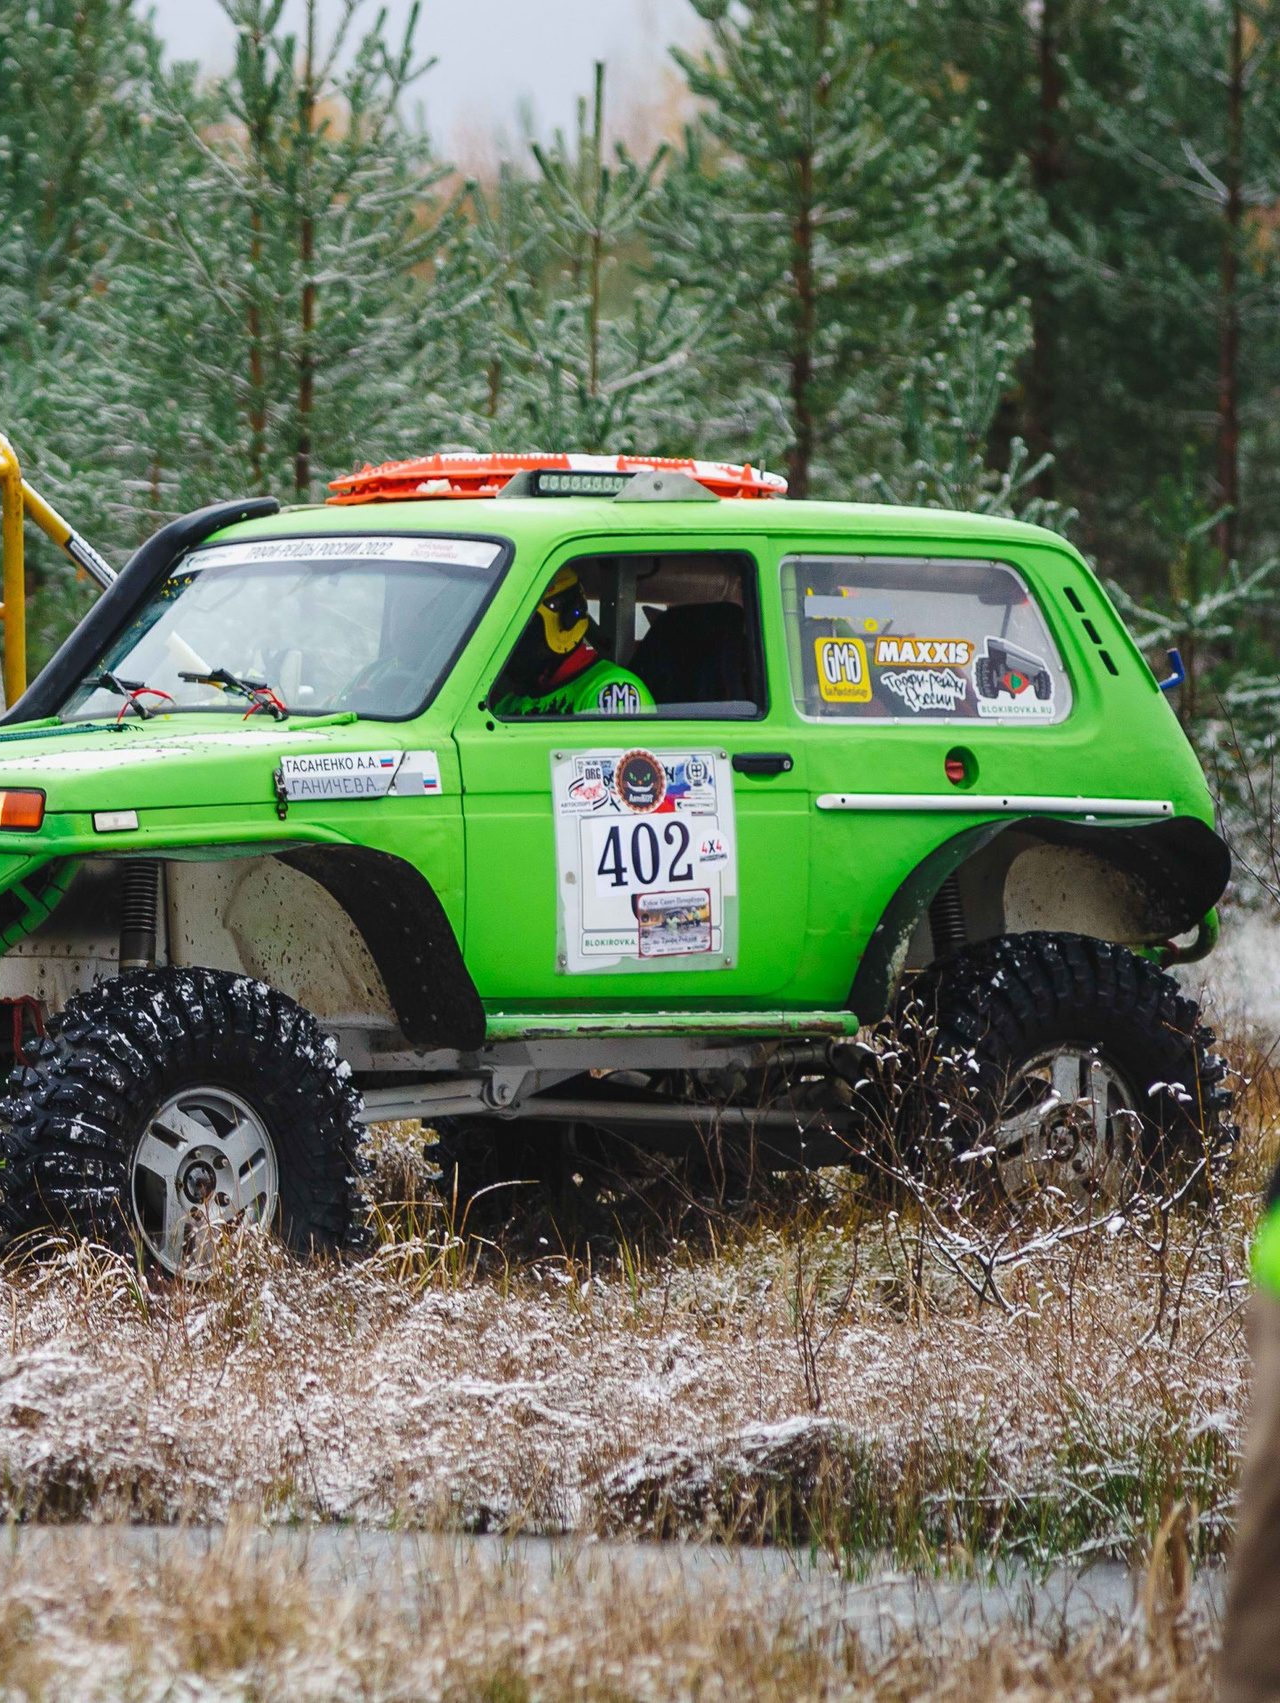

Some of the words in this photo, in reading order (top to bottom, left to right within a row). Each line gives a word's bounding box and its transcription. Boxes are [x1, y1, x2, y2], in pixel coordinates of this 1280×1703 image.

[878, 641, 969, 664] MAXXIS
[981, 706, 1052, 714] BLOKIROVKA.RU
[286, 757, 354, 773] ГАСАНЕНКО
[585, 768, 601, 780] ORG
[597, 821, 694, 887] 402
